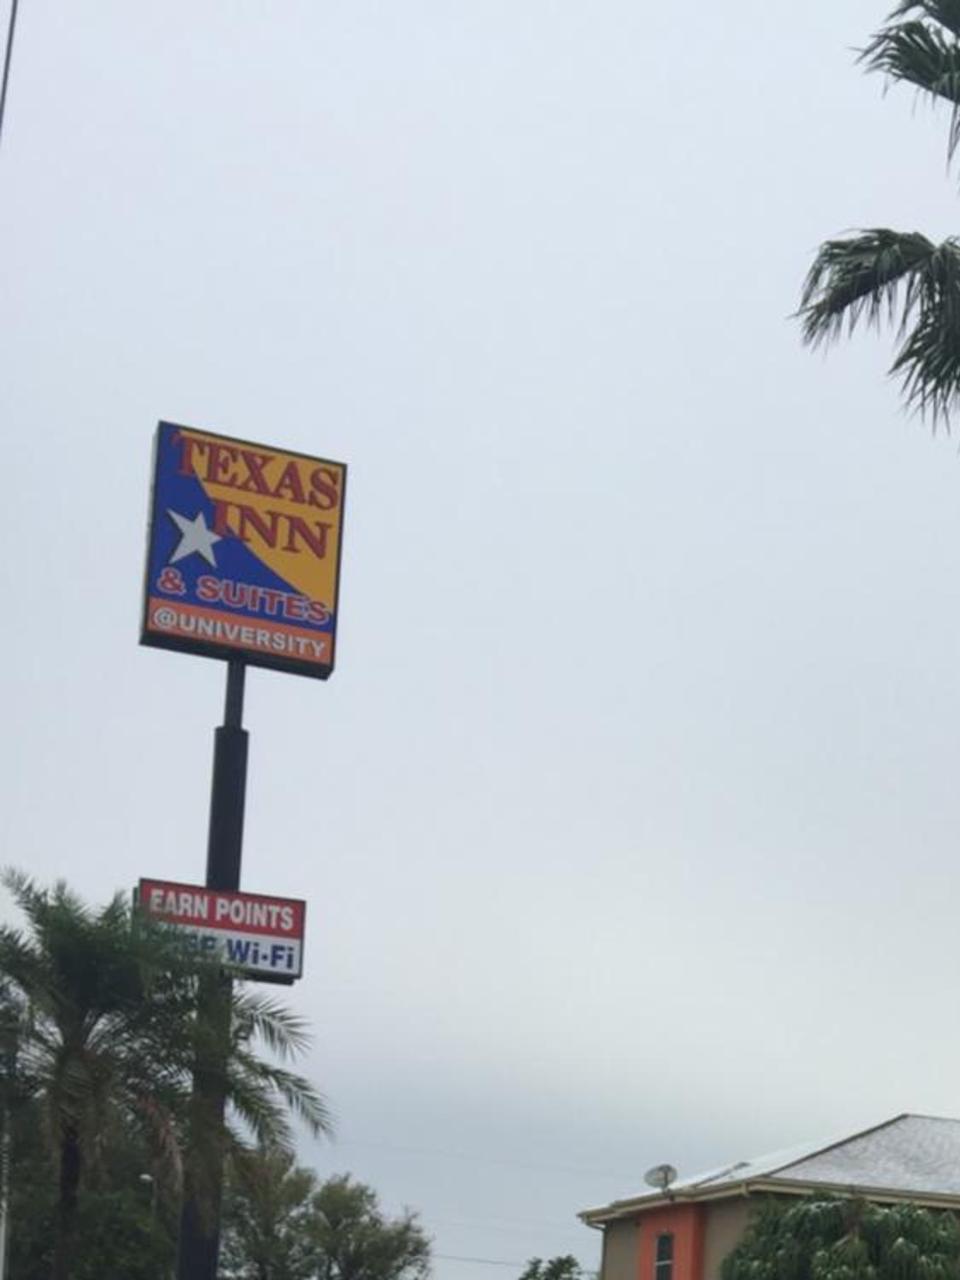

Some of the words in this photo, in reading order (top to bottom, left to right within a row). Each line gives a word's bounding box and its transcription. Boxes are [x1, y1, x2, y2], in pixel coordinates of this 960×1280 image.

[172, 432, 339, 510] TEXAS
[211, 498, 331, 559] INN
[156, 566, 186, 596] &
[196, 575, 330, 625] SUITES
[153, 607, 326, 657] @UNIVERSITY
[151, 888, 208, 920] EARN
[215, 896, 294, 931] POINTS
